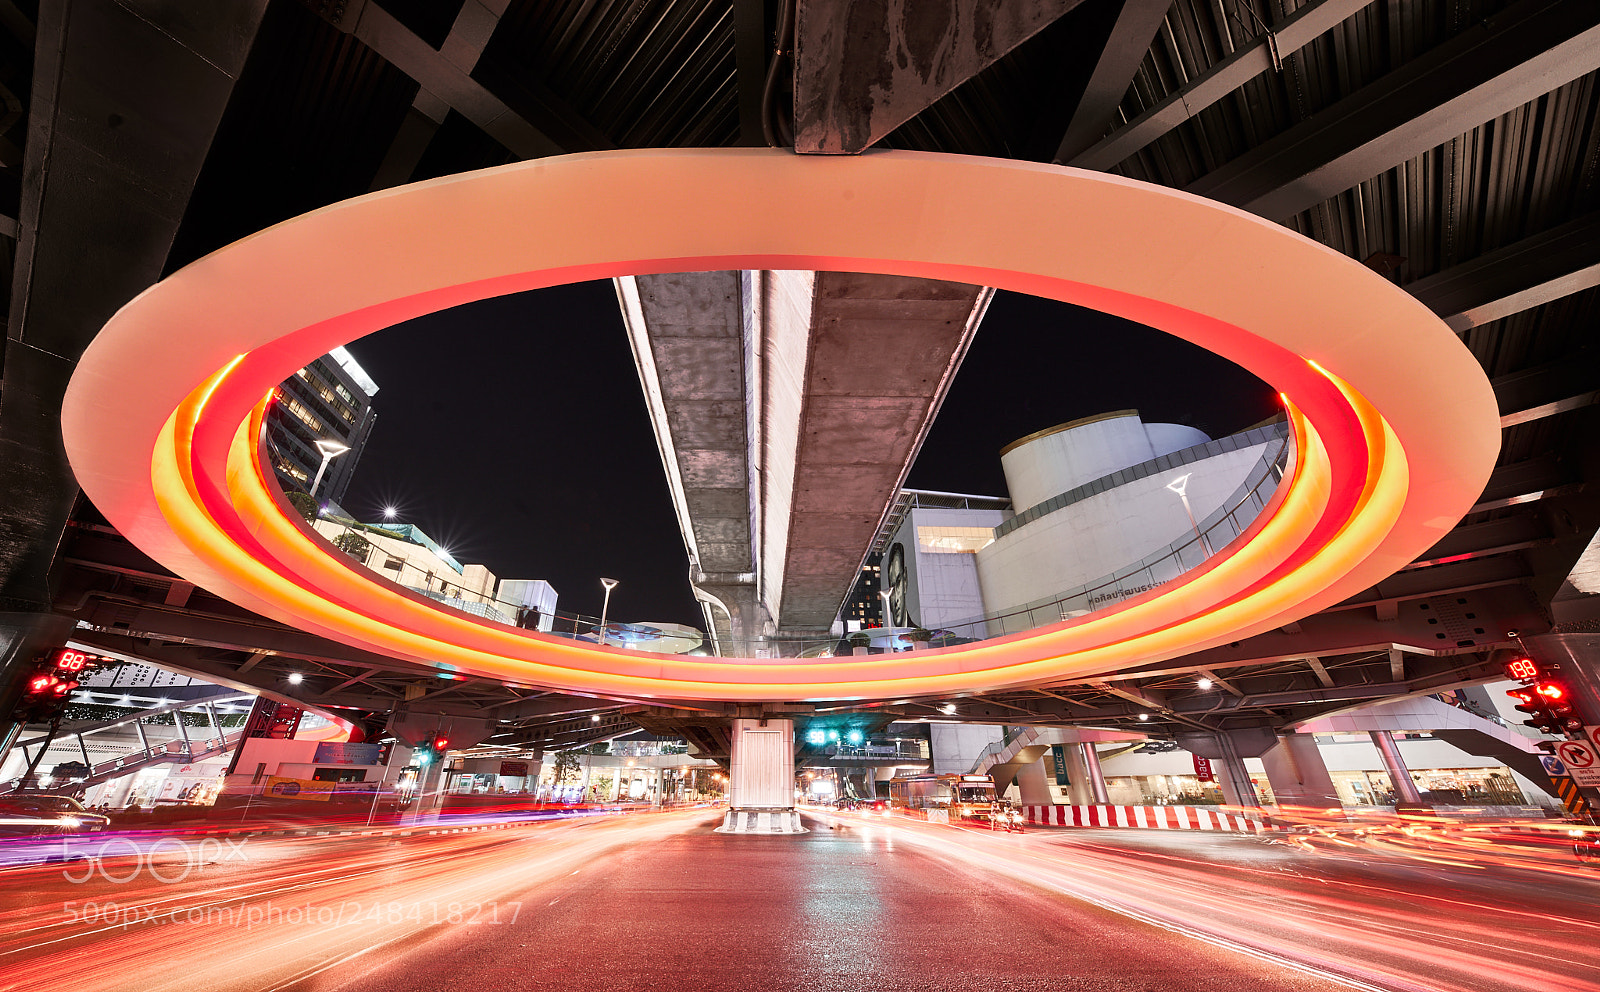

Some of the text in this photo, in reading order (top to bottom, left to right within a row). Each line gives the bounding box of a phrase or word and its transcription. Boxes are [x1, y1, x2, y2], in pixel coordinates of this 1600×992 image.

[59, 652, 85, 670] 88
[1509, 660, 1537, 678] 198
[1054, 752, 1065, 775] bacc
